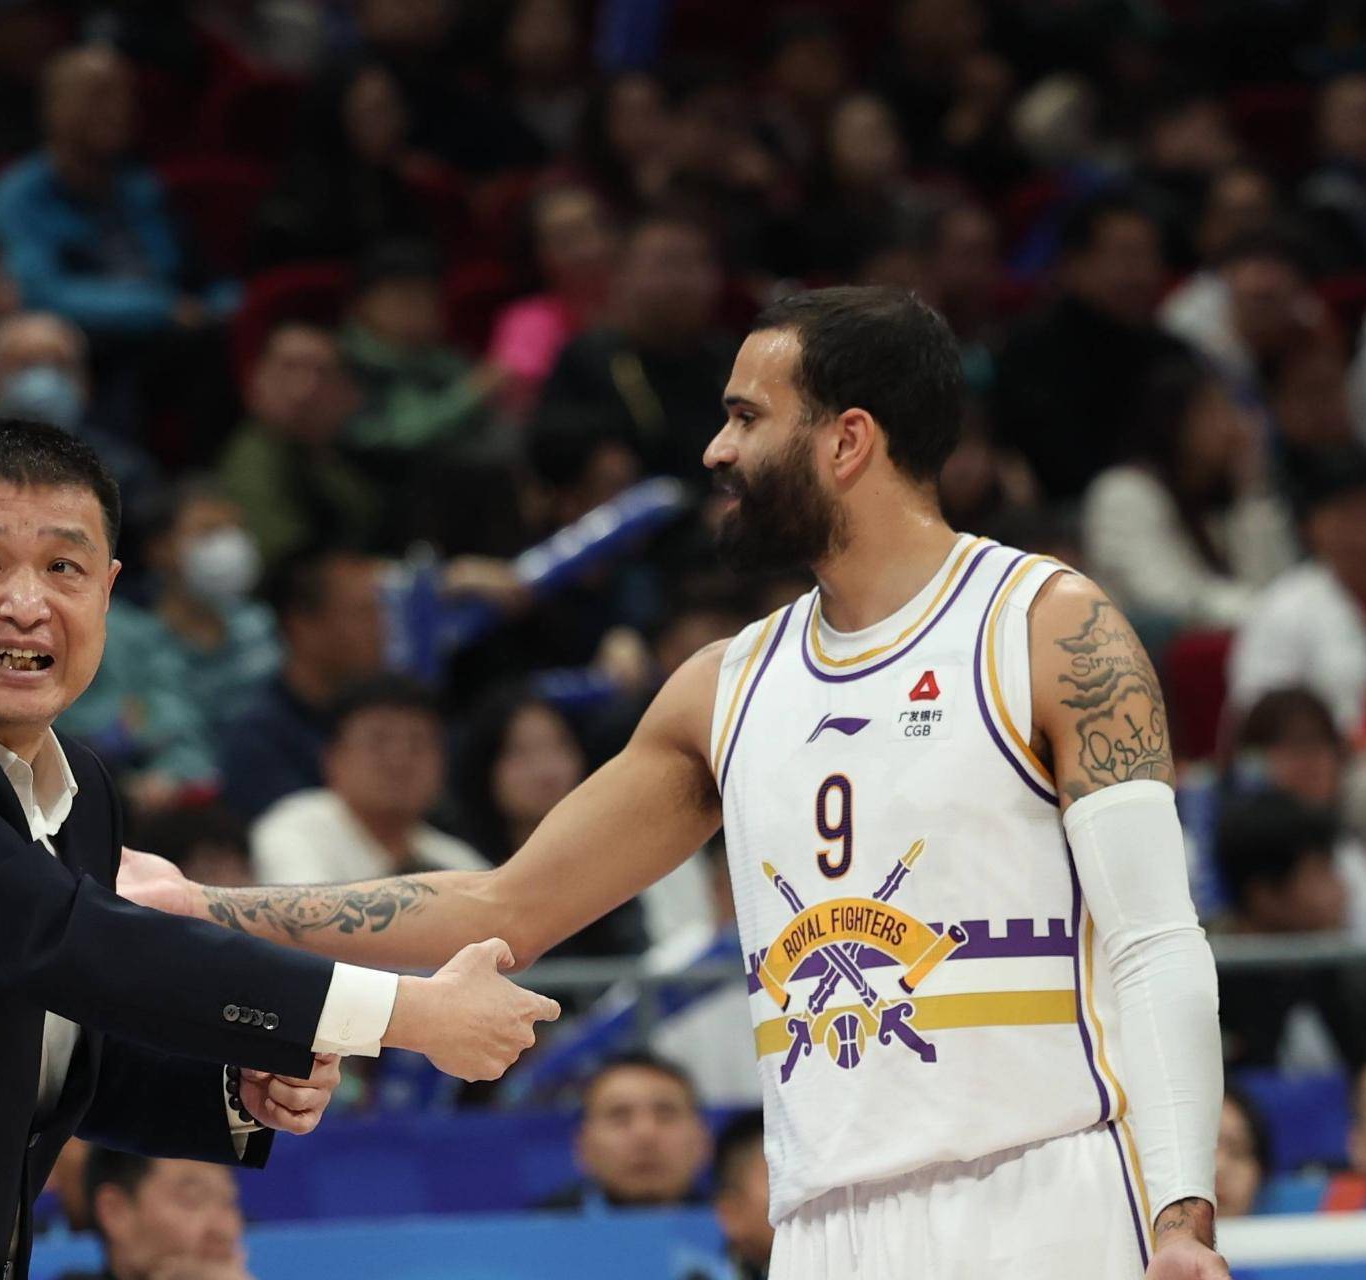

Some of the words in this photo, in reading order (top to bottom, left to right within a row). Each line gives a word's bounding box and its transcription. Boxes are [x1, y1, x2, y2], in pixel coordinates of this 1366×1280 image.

[899, 710, 942, 722] 广发银行
[905, 725, 931, 736] CGB
[815, 773, 854, 880] 9
[782, 914, 827, 962] ROYAL
[831, 906, 907, 946] FIGHTERS
